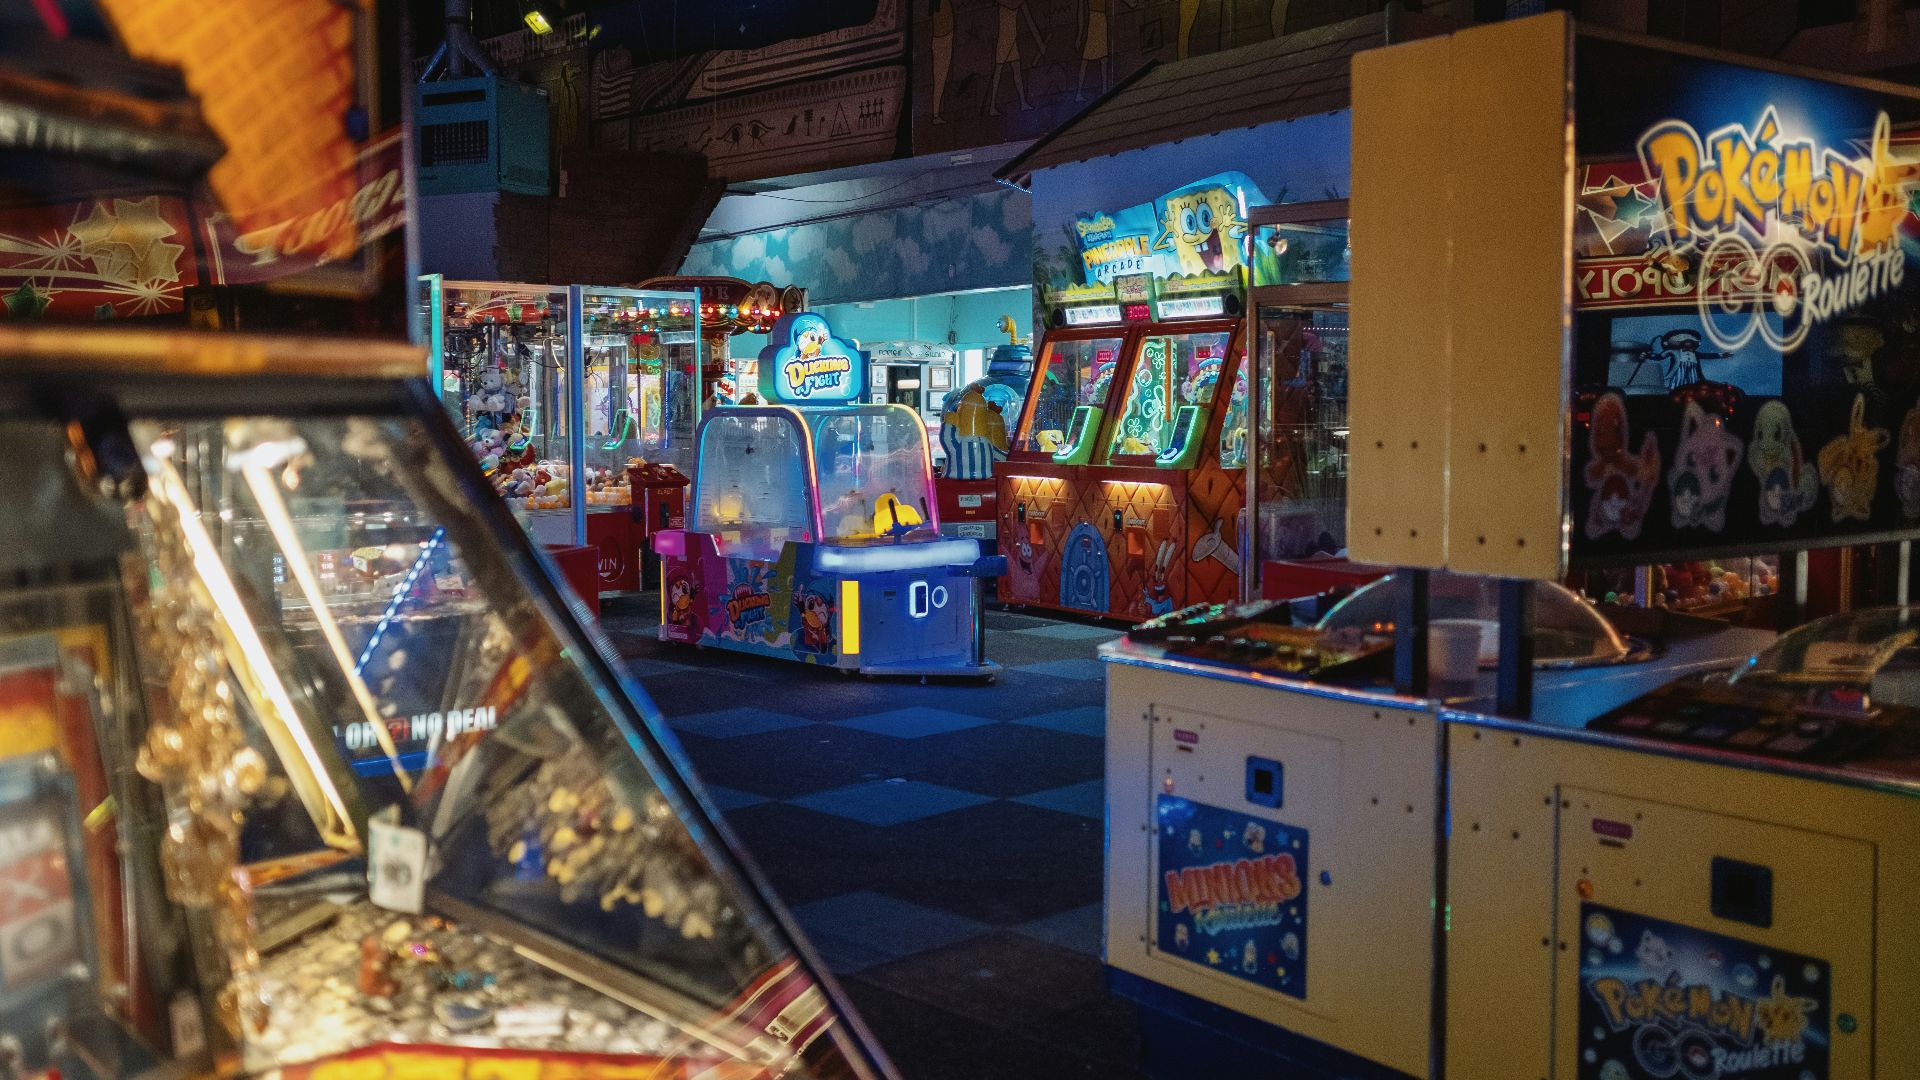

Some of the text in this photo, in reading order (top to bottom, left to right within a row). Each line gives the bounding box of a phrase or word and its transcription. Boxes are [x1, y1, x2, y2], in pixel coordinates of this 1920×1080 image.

[1083, 235, 1150, 271] PINEAPPLE
[1097, 259, 1141, 278] ARCADE
[1801, 236, 1906, 327] Roulette
[795, 373, 842, 396] FIGHT
[411, 712, 443, 740] NO
[446, 705, 497, 736] DEAL
[1165, 854, 1300, 913] MINIONS
[1711, 1038, 1806, 1074] Roulette
